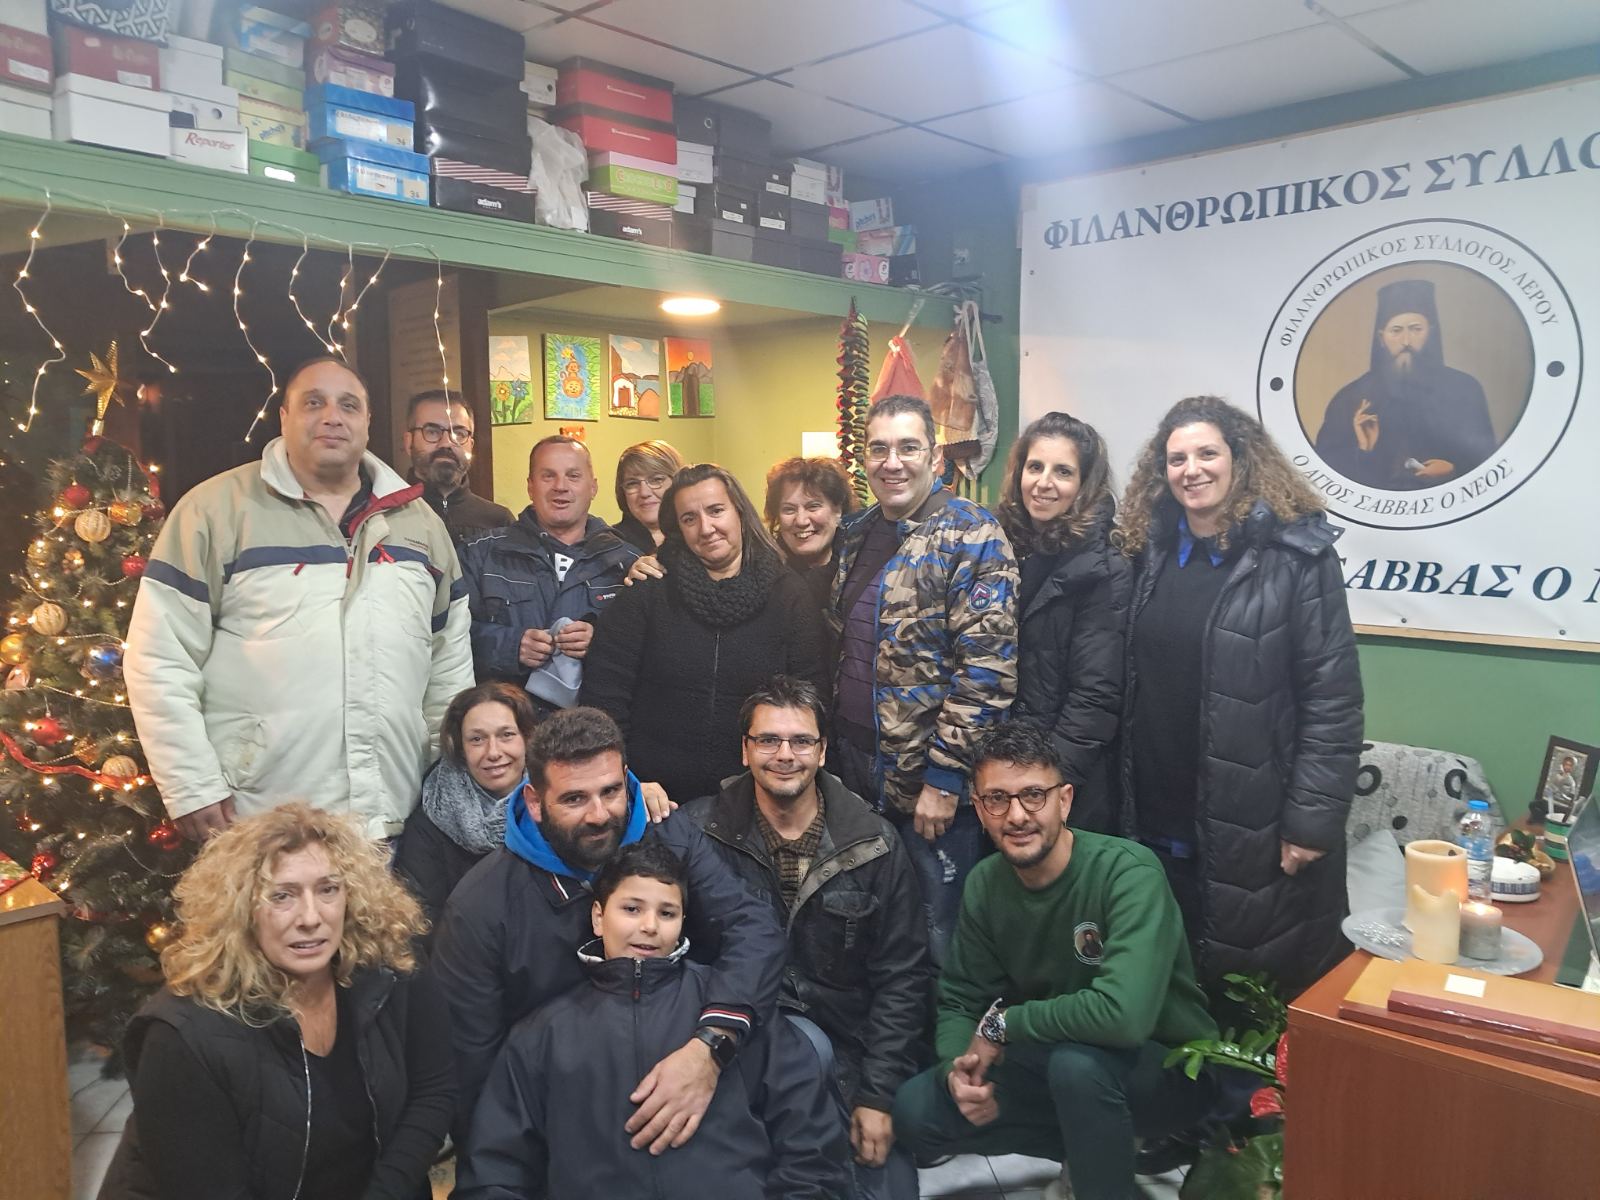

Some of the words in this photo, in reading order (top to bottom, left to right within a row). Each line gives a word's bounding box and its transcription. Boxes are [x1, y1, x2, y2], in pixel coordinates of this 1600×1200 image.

[185, 132, 235, 150] Reporter
[1043, 163, 1412, 250] ΦΙΛΑΝΘΡΩΠΙΚΟΣ
[1280, 238, 1407, 347] ΦΙΛΑΝΘΡΩΠΙΚΟΣ
[1413, 234, 1516, 274] ΣΥΛΛΟΓΟΣ
[1512, 271, 1559, 325] ΛΕΡΟΥ
[1293, 454, 1310, 467] Ο
[1302, 469, 1354, 504] ΑΓΙΟΣ
[1353, 494, 1434, 515] ΣΑΒΒΑΣ
[1441, 491, 1455, 509] Ο
[1461, 458, 1514, 503] ΝΕΟΣ
[1338, 557, 1522, 599] ΑΒΒΑΣ
[1532, 566, 1572, 601] Ο
